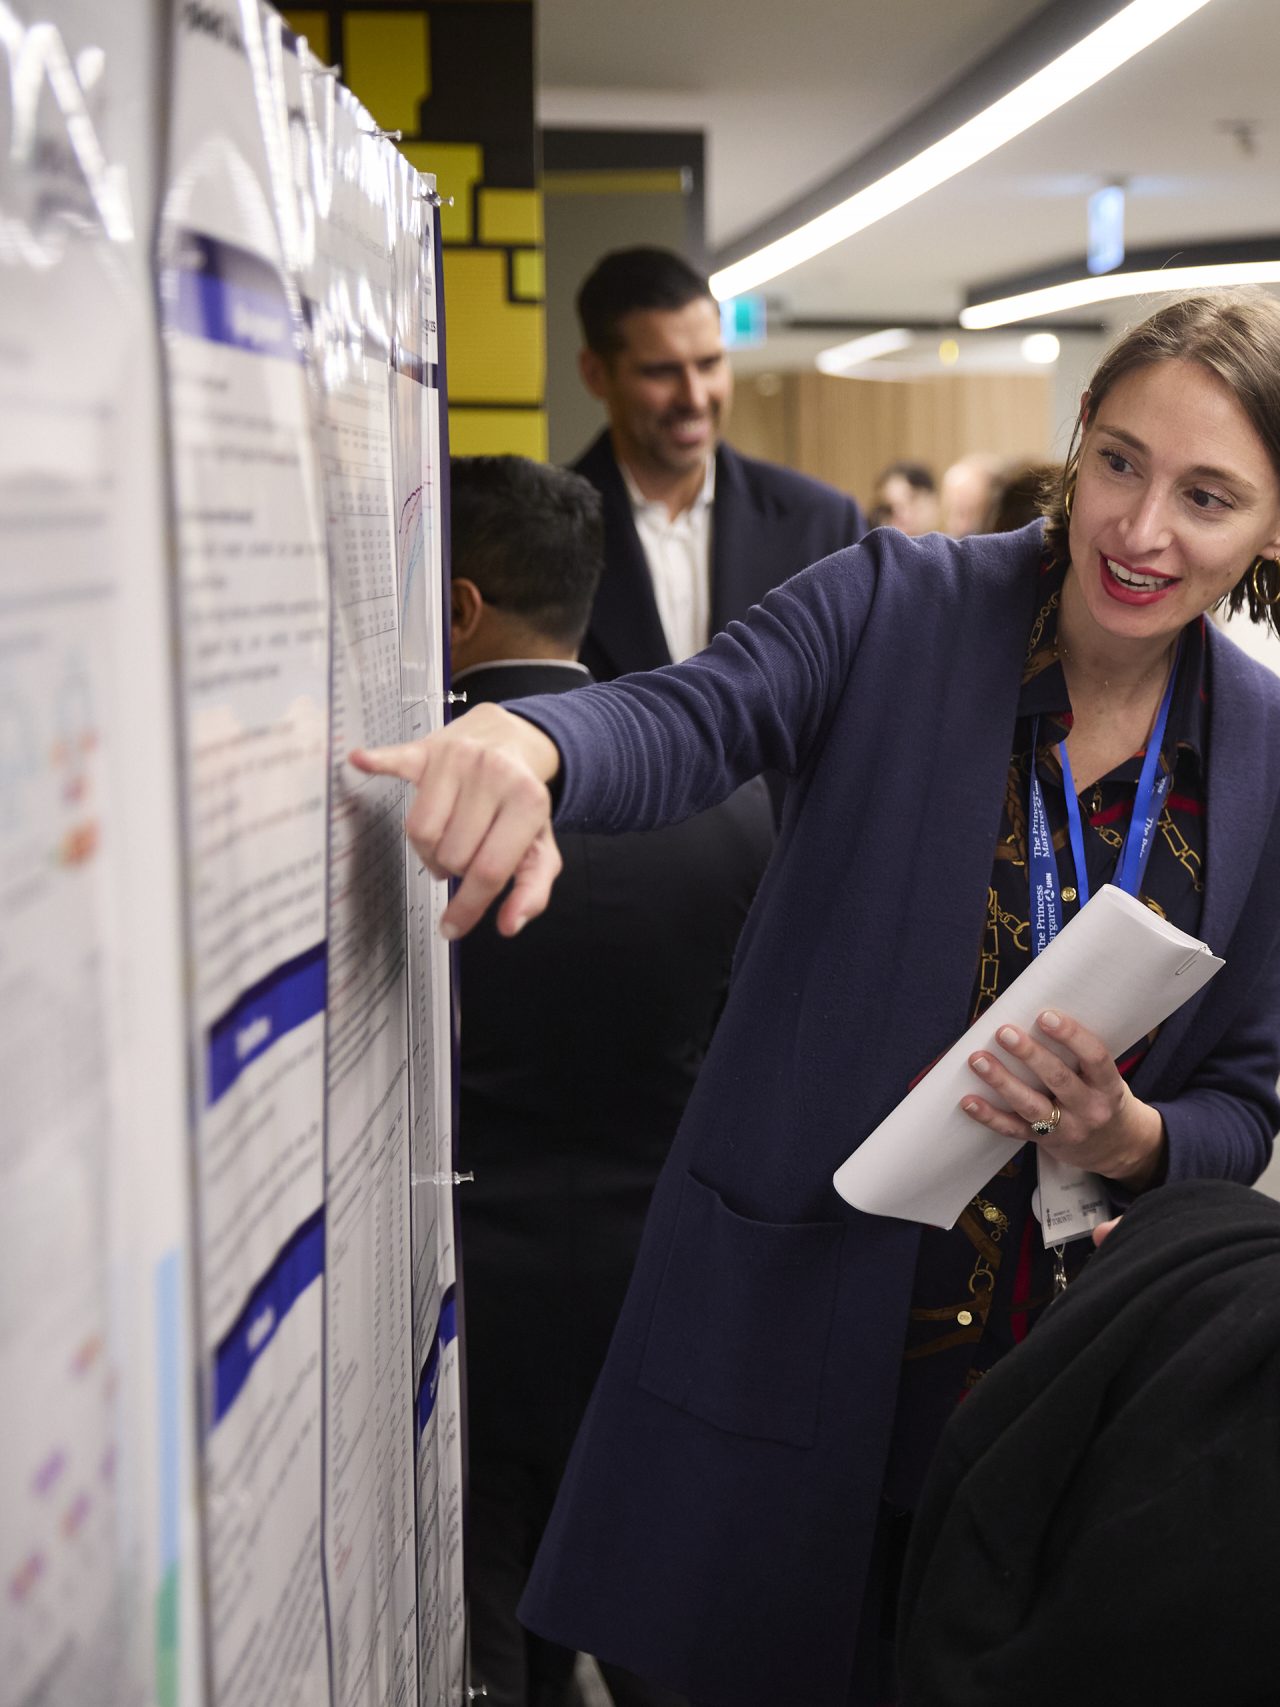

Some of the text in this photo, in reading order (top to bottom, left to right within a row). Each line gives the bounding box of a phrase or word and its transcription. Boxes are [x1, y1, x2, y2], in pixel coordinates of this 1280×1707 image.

[1039, 809, 1050, 858] Margaret
[1036, 884, 1046, 954] The Princess
[1047, 903, 1058, 944] argaret
